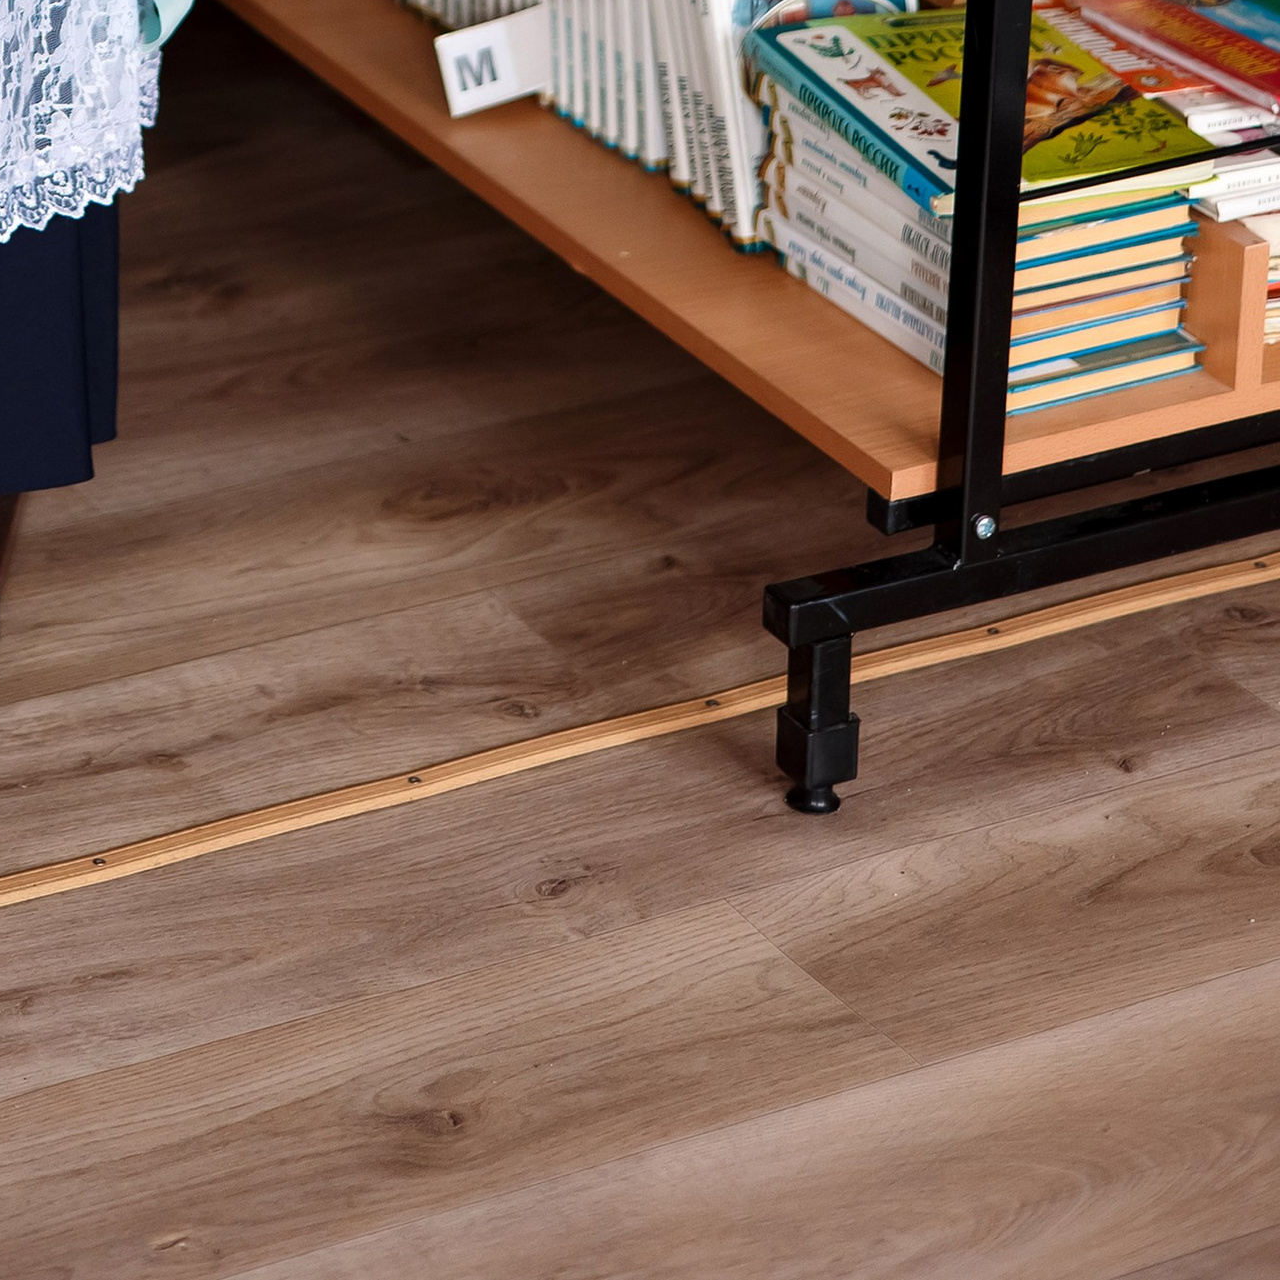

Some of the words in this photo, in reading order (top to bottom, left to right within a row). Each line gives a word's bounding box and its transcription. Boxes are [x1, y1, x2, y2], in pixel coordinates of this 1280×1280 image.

[453, 45, 498, 92] М
[799, 84, 851, 141] ПРИРОДА
[851, 126, 902, 182] РОССИИ
